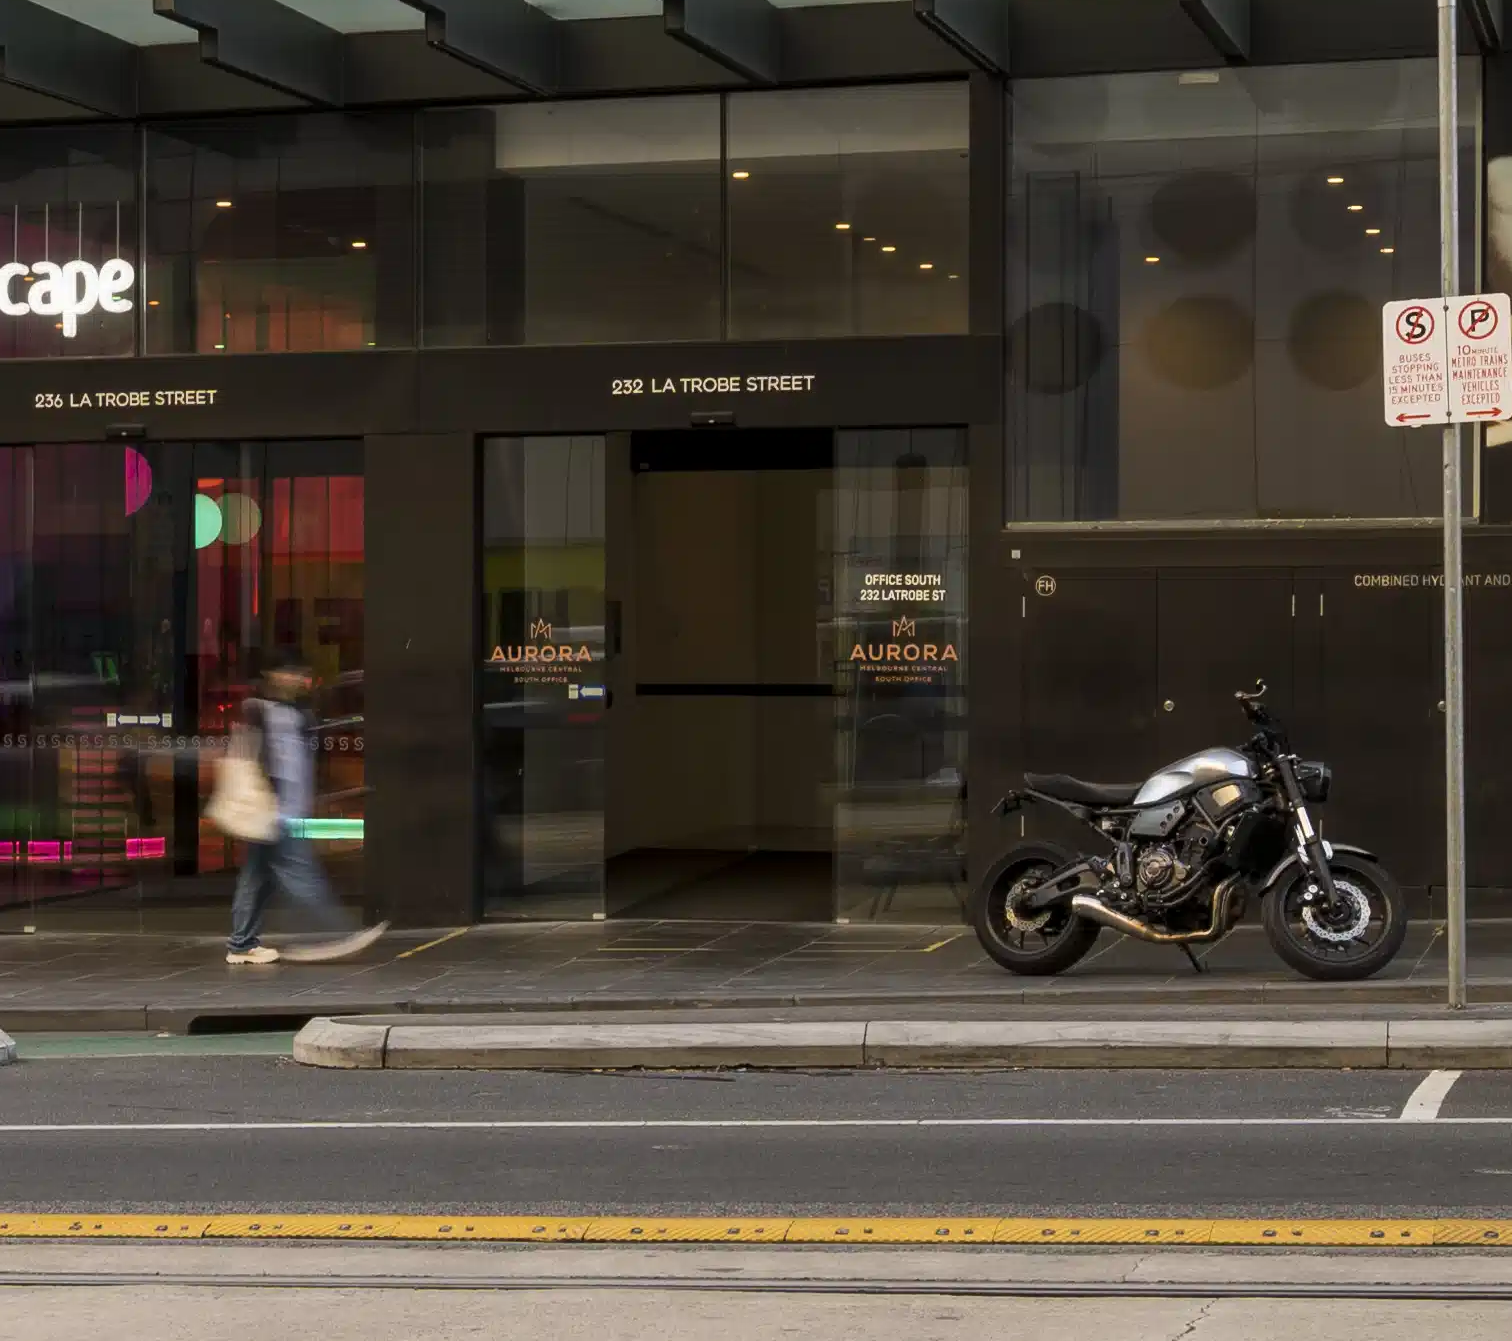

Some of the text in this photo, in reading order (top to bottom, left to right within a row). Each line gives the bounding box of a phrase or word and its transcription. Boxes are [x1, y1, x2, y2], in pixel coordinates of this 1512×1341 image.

[1457, 345, 1471, 356] 10
[1400, 353, 1431, 363] BUSES
[1451, 354, 1508, 368] METRO TRAINS
[1392, 363, 1439, 374] STOPPING
[1452, 367, 1507, 381] MAINTENANCE
[1389, 373, 1442, 384] LESS THAN
[612, 375, 815, 395] 232 LA TROBE STREET
[1389, 383, 1444, 395] 15 MINUTES
[1462, 380, 1499, 392] VEHICLES
[35, 389, 217, 408] 236 LA TROBE STREET
[1391, 394, 1441, 404] EXCEPTED
[1461, 393, 1500, 405] EXCEPTED
[865, 574, 941, 586] OFFICE SOUTH
[1038, 580, 1054, 591] FH
[1354, 574, 1419, 587] COMBINED
[1422, 574, 1481, 587] HYDNT
[1484, 574, 1510, 586] AND
[860, 589, 946, 601] 232 LATROBE ST
[491, 645, 592, 662] AURORA
[850, 644, 959, 661] AURORA
